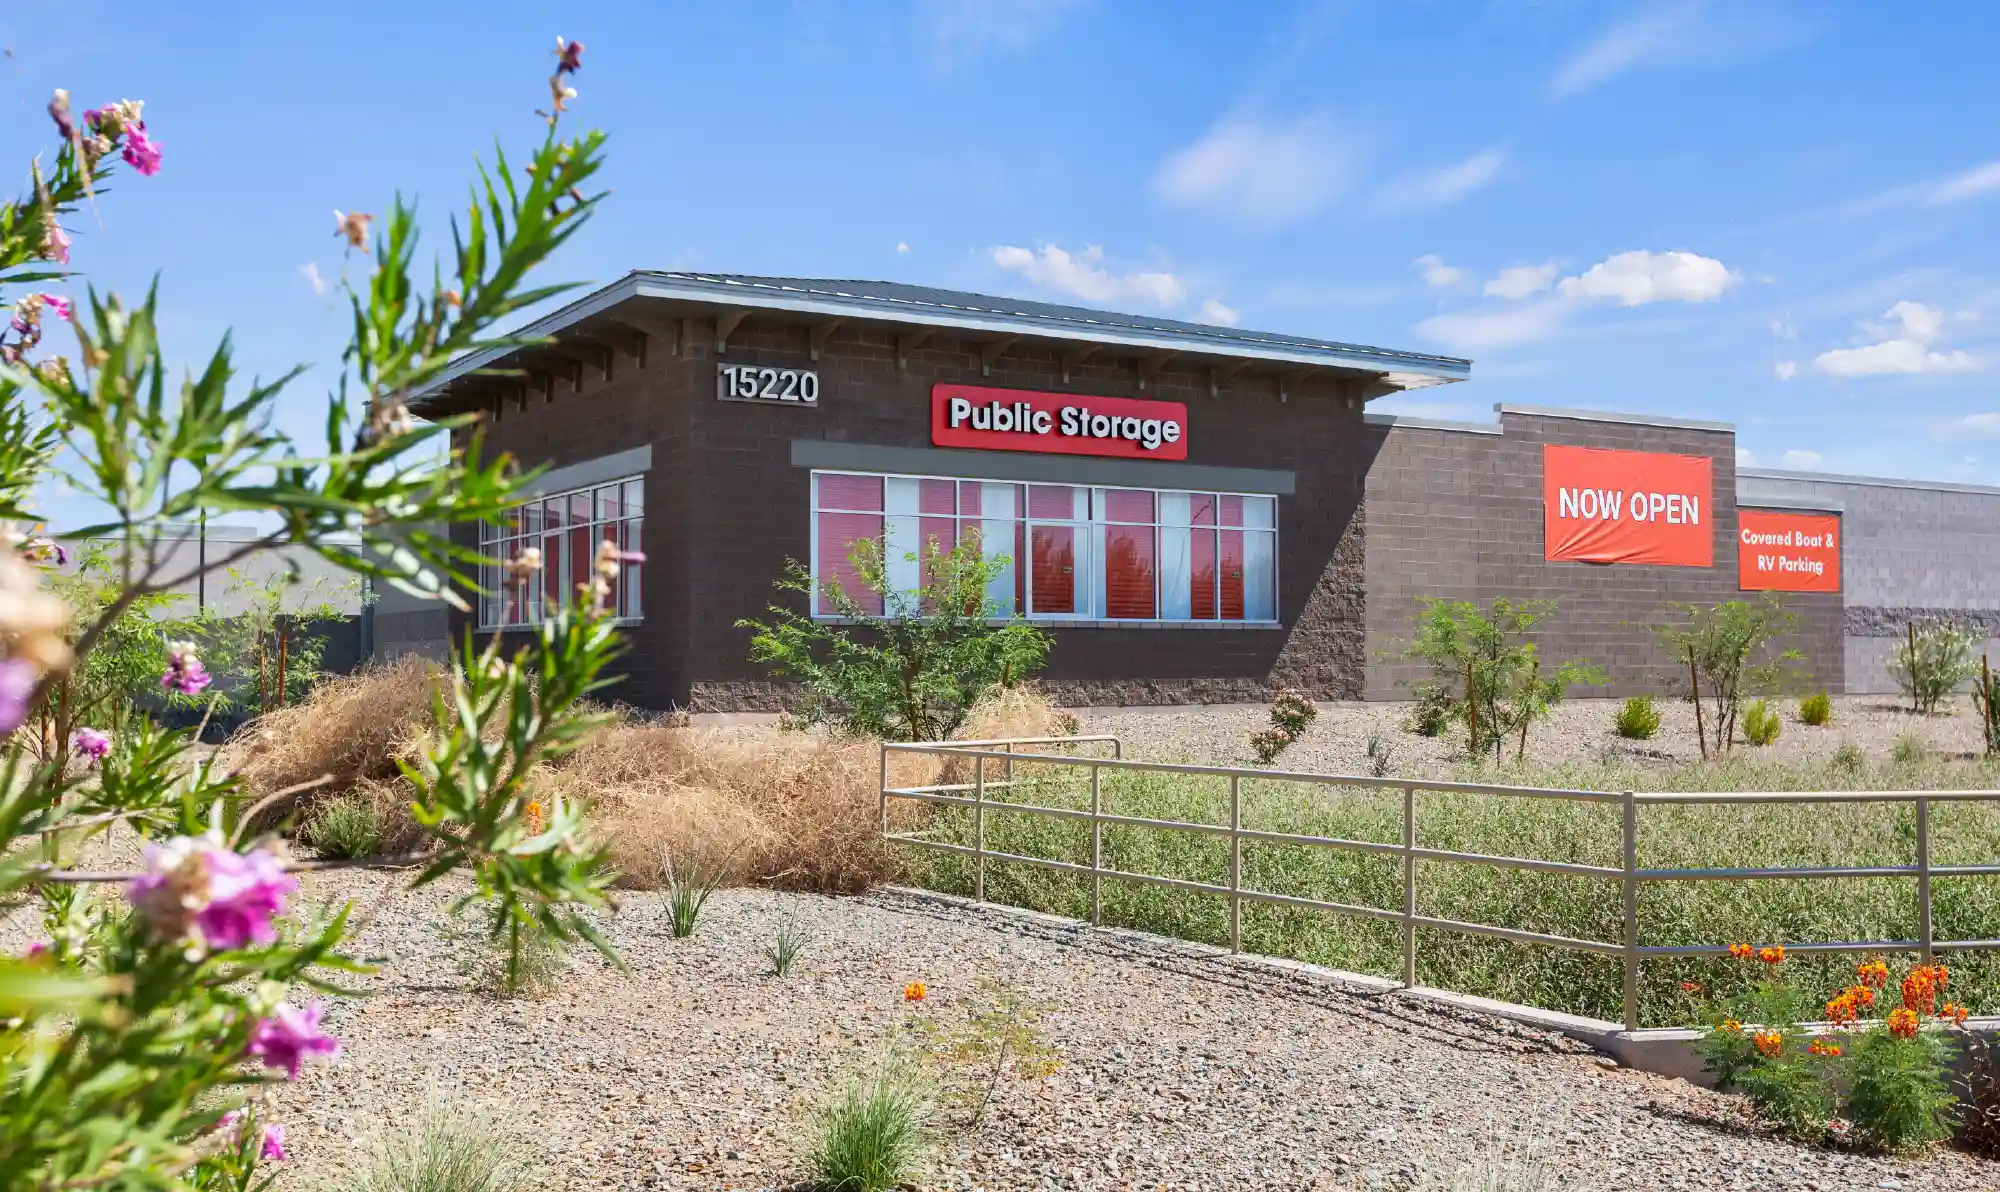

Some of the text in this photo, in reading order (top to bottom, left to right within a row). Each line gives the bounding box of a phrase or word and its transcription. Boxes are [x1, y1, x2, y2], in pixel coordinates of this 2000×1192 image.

[723, 366, 819, 403] 15220
[949, 398, 1181, 450] Public Storage
[1559, 487, 1699, 525] NOW OPEN
[1741, 528, 1835, 548] Covered Boat &
[1757, 555, 1824, 576] RV Parking
